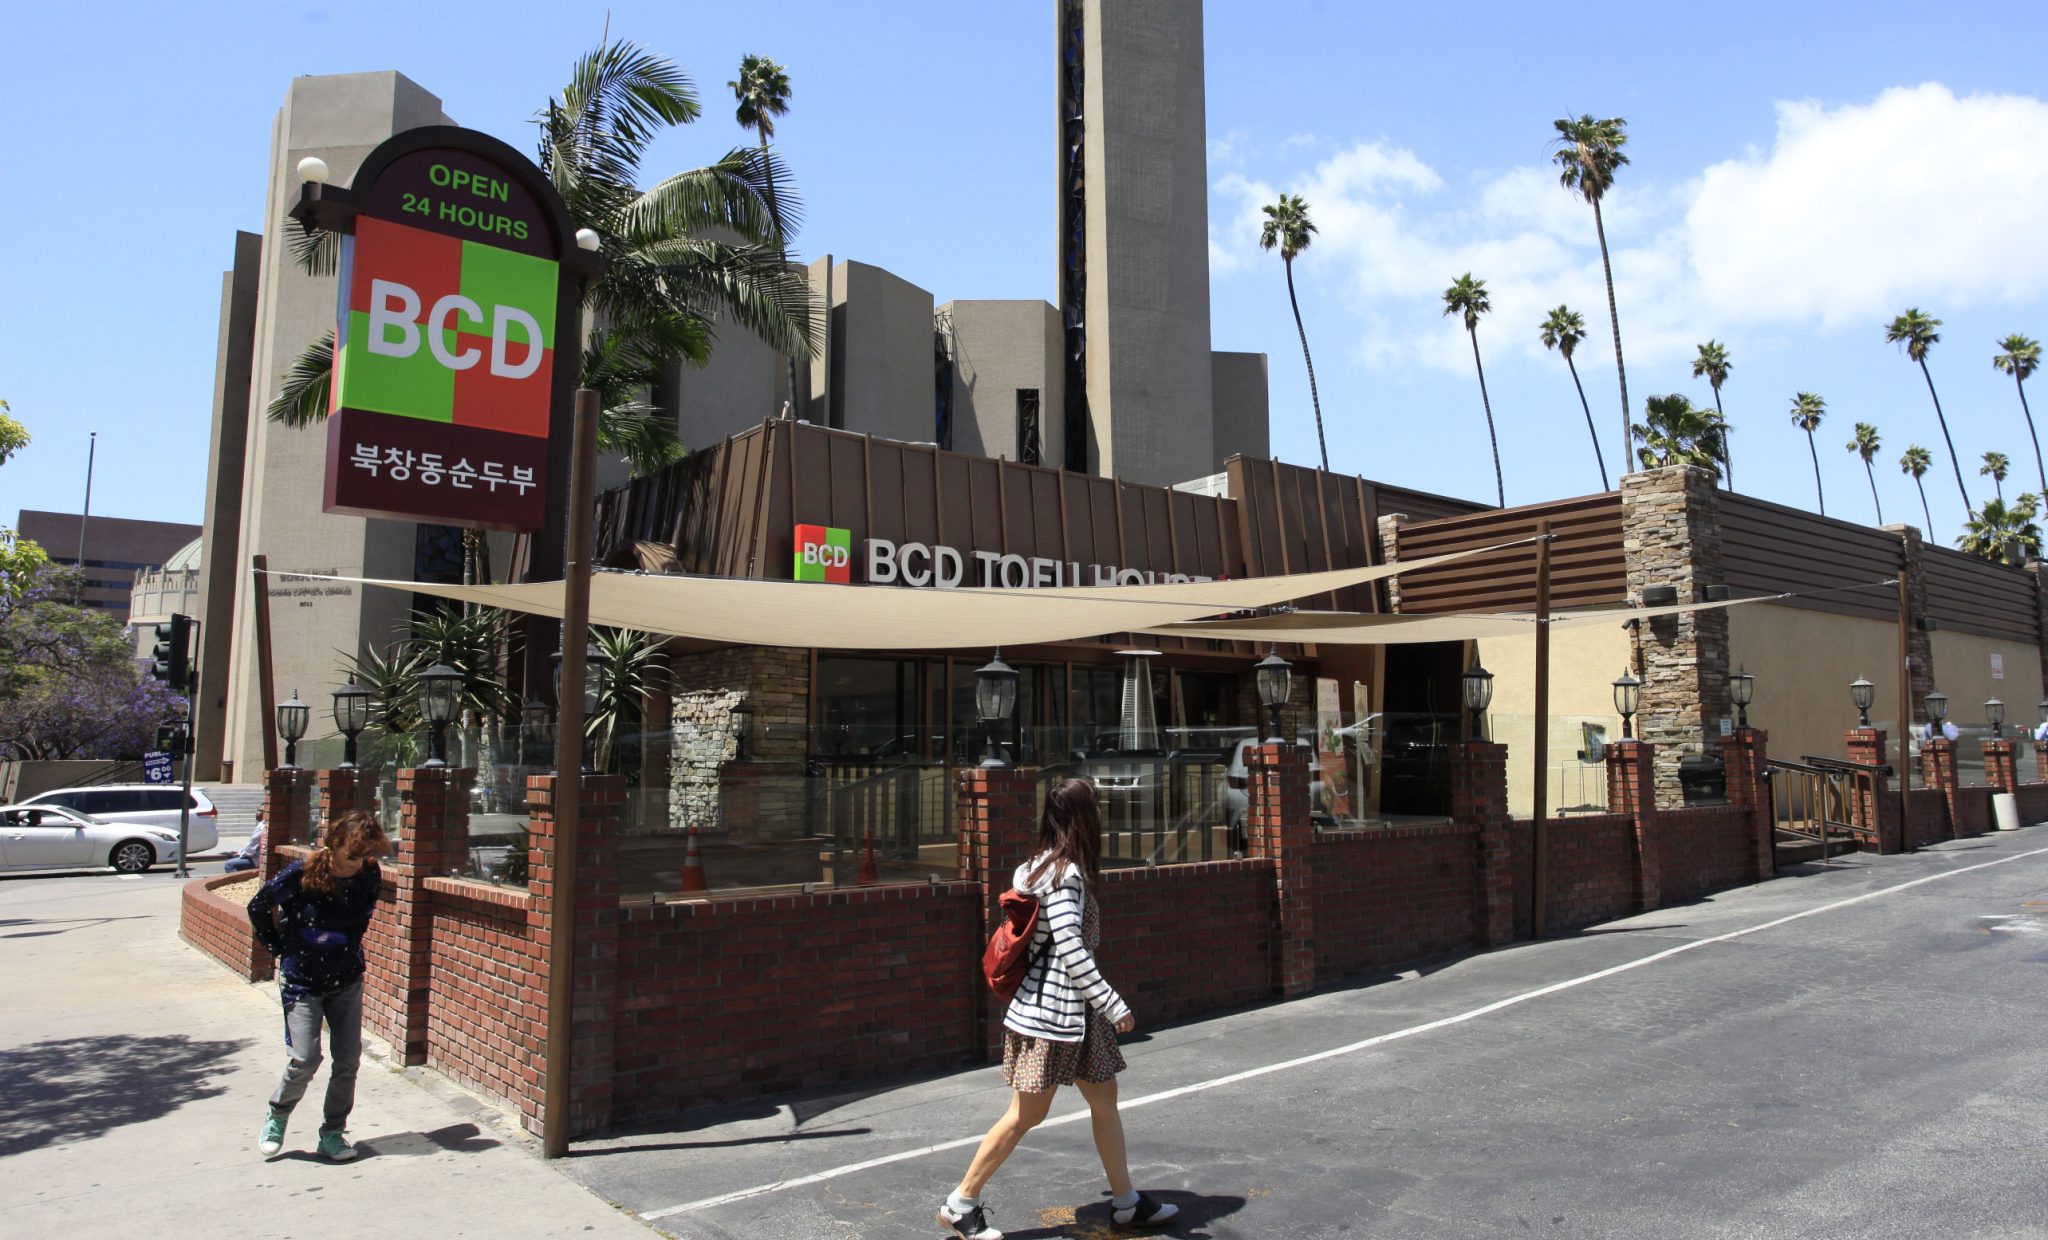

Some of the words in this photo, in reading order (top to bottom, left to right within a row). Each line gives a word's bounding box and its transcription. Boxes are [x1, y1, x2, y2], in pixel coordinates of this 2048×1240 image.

[429, 164, 509, 202] OPEN
[402, 193, 431, 216] 24
[439, 201, 529, 240] HOURS
[367, 278, 544, 380] BCD
[350, 443, 537, 496] 북창동순두부
[804, 542, 848, 568] BCD
[865, 538, 964, 588] BCD
[144, 751, 170, 759] PUBL
